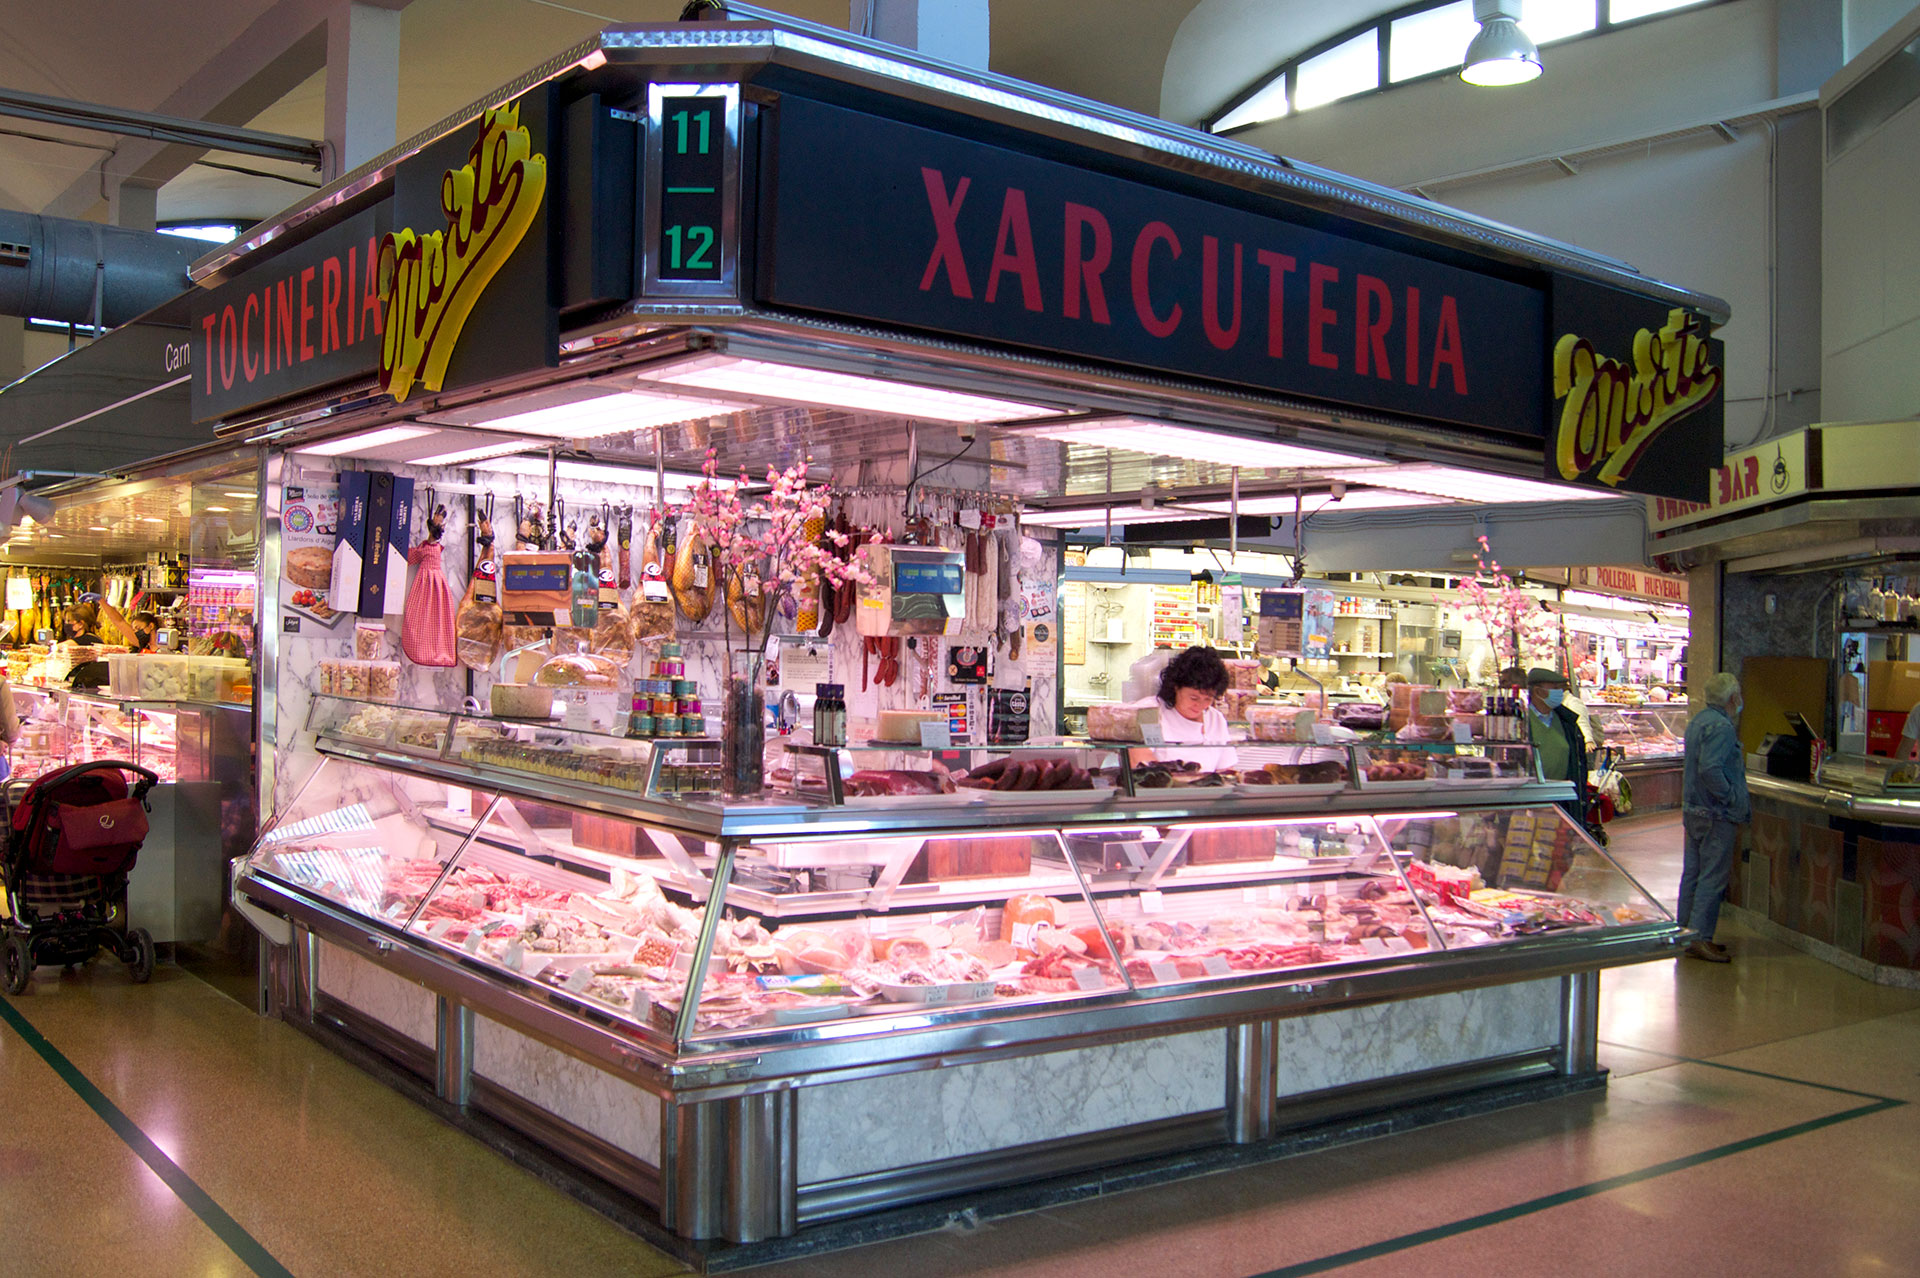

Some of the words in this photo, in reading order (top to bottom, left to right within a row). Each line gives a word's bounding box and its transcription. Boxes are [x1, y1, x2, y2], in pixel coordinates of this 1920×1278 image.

[672, 110, 711, 154] 11
[665, 225, 714, 270] 12
[919, 166, 1469, 396] XARCUTERIA
[202, 236, 383, 396] TOCINERIA
[1717, 455, 1760, 505] BAR
[287, 535, 314, 544] Llardons
[1597, 567, 1637, 592] POLLERIA
